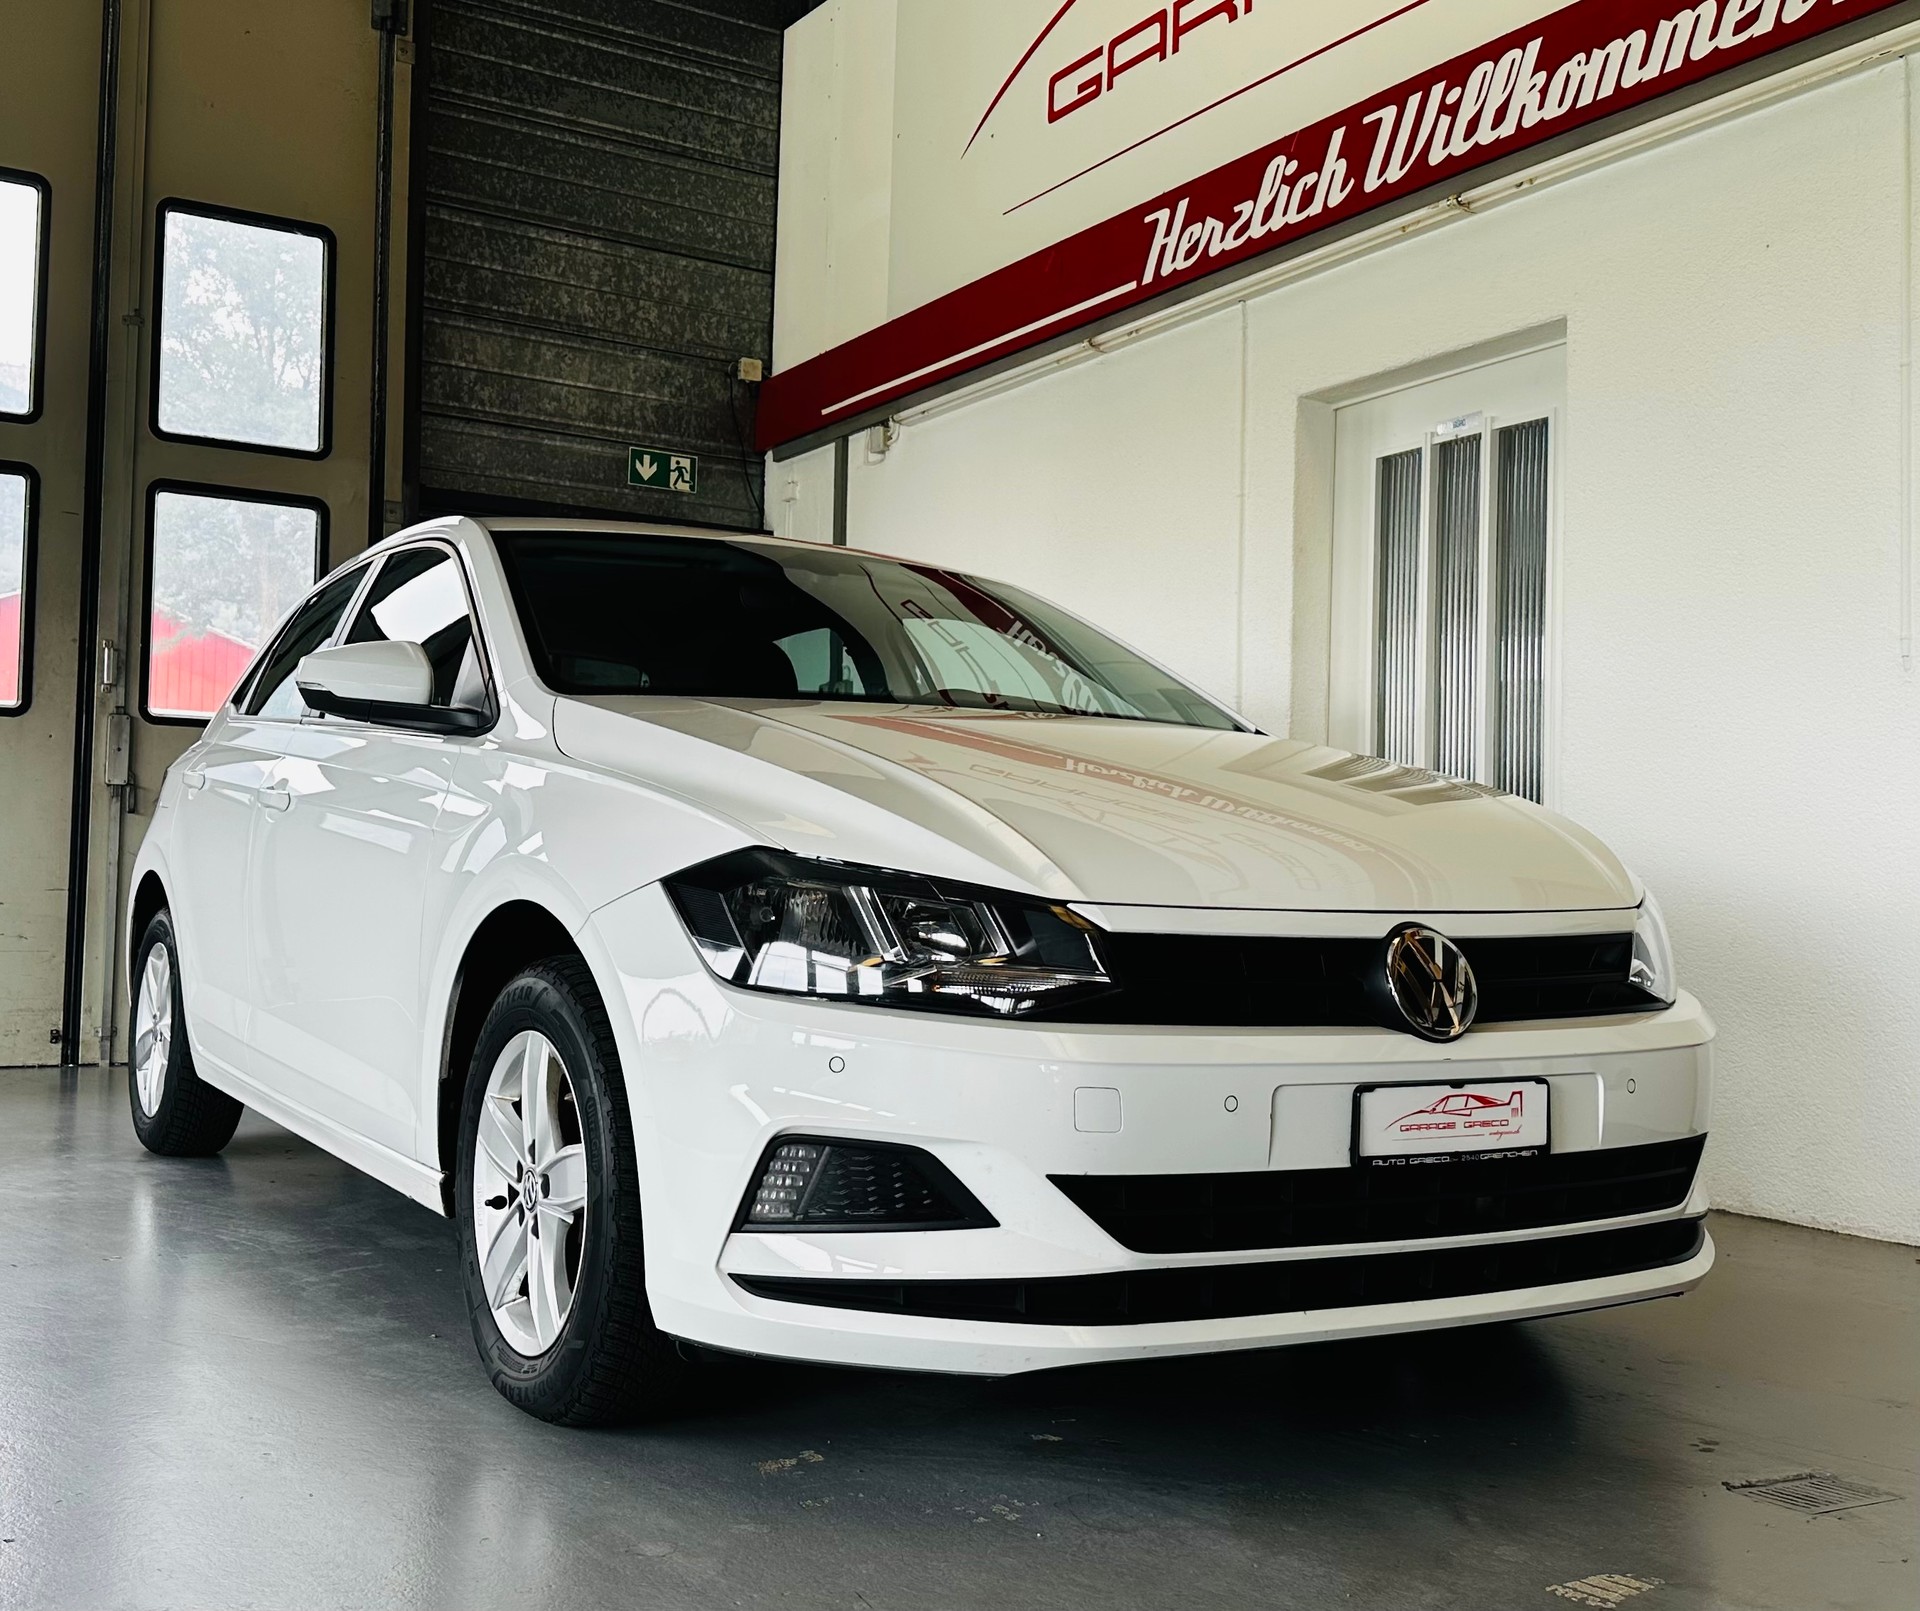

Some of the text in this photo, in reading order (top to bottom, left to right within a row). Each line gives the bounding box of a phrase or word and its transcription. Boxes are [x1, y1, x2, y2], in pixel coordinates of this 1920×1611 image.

[1048, 0, 1252, 124] GAR
[1141, 125, 1355, 286] Herzlich
[1388, 928, 1477, 1038] VW
[1372, 1158, 1406, 1166] AUTO
[1409, 1156, 1450, 1165] GRECO
[1400, 1119, 1509, 1132] GARAGE GRECO
